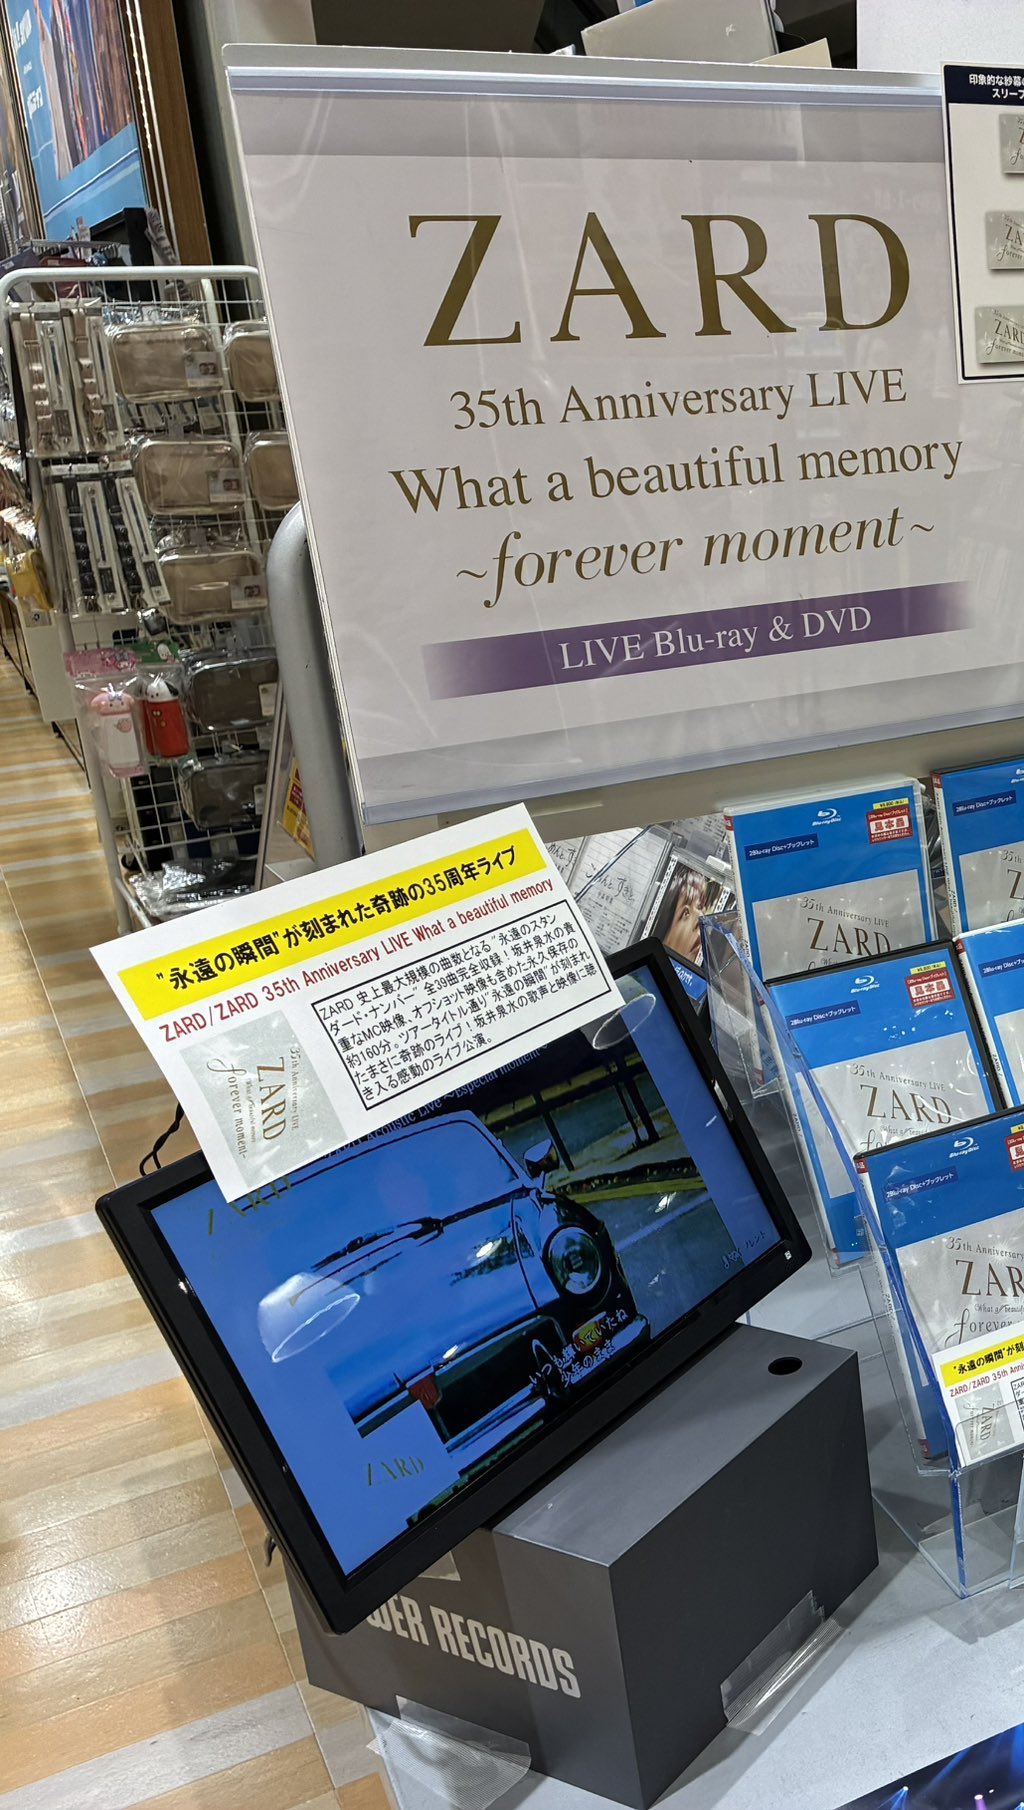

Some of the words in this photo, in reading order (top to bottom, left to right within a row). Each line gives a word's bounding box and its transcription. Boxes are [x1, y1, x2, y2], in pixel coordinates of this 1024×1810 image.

[408, 211, 911, 346] ZARD
[450, 388, 545, 429] 35th
[560, 379, 795, 425] Anniversary
[808, 367, 907, 408] LIVE
[389, 466, 531, 514] What
[548, 472, 573, 501] a
[584, 444, 785, 499] beautiful
[799, 436, 963, 481] memory
[559, 634, 645, 670] LIVE
[654, 618, 759, 658] Blu-ray
[768, 614, 794, 641] &
[802, 606, 872, 639] DVD
[159, 991, 258, 1042] ZARD/ZARD
[262, 977, 300, 1001] 35th
[302, 940, 381, 987] Anniversary
[381, 931, 414, 956] LIVE
[414, 919, 446, 942] What
[447, 916, 458, 930] a
[456, 892, 510, 925] beautiful
[511, 877, 554, 904] memory
[807, 917, 891, 956] ZARD
[257, 1057, 286, 1141] ZARD
[859, 1084, 952, 1125] ZARD
[945, 1236, 972, 1252] 35th
[975, 1243, 1024, 1260] Anniversary
[949, 1376, 990, 1398] ZARD/ZARD
[993, 1369, 1008, 1381] 35th
[429, 1605, 581, 1699] RECORDS
